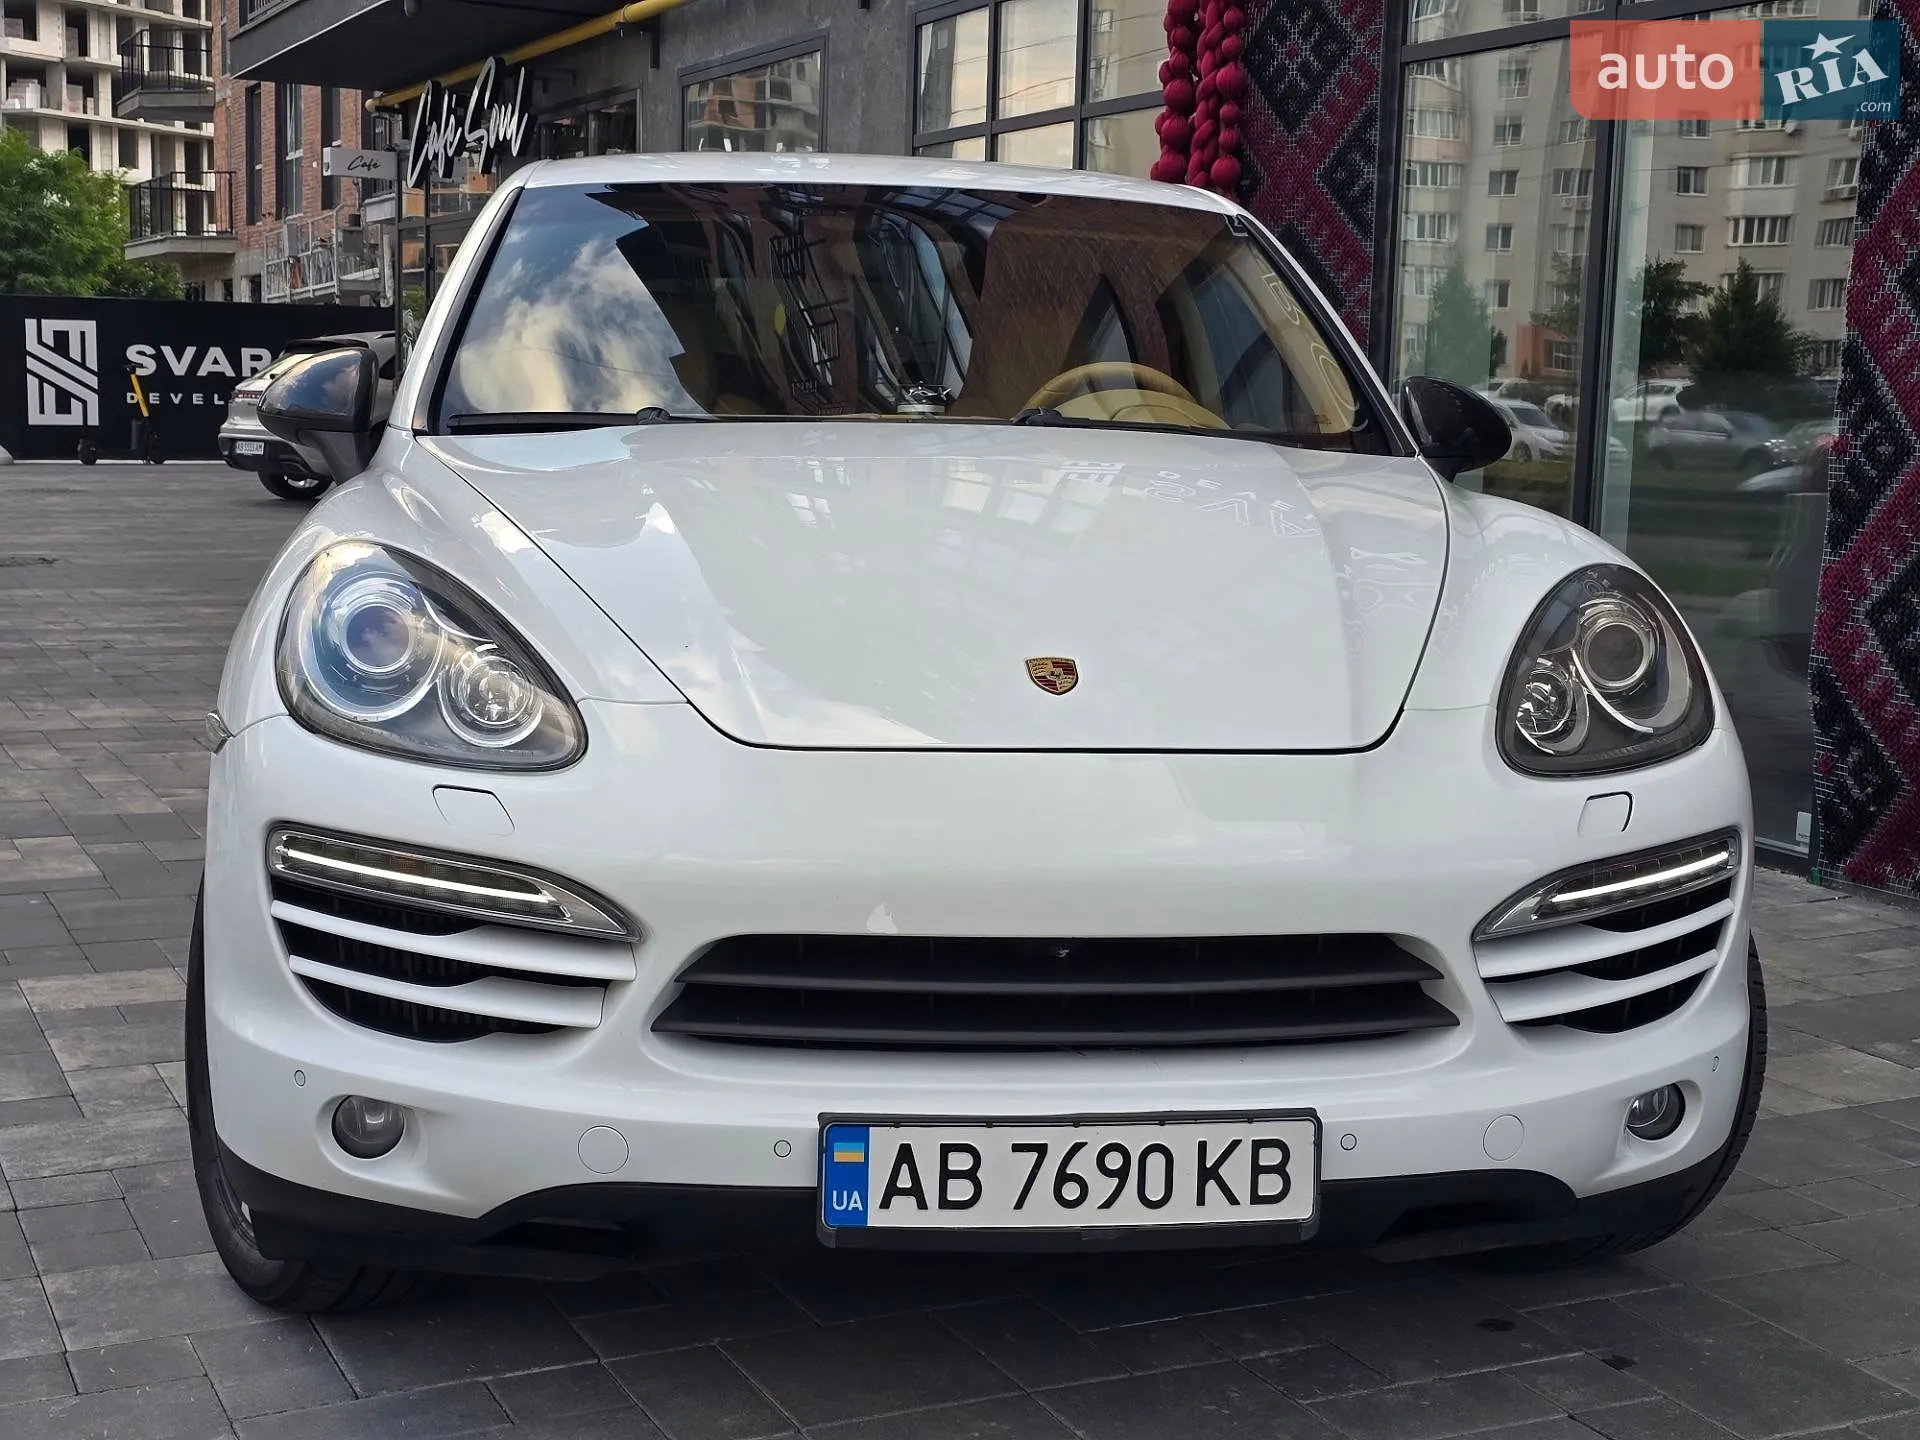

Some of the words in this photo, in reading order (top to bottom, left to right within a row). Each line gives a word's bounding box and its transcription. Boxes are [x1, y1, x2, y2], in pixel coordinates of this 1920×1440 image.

[407, 79, 462, 188] Café
[464, 56, 528, 174] Soul
[126, 344, 285, 377] SVAR
[878, 1142, 983, 1210] AB
[1011, 1141, 1174, 1210] 7690
[1196, 1138, 1291, 1206] KB
[832, 1190, 863, 1211] UA
